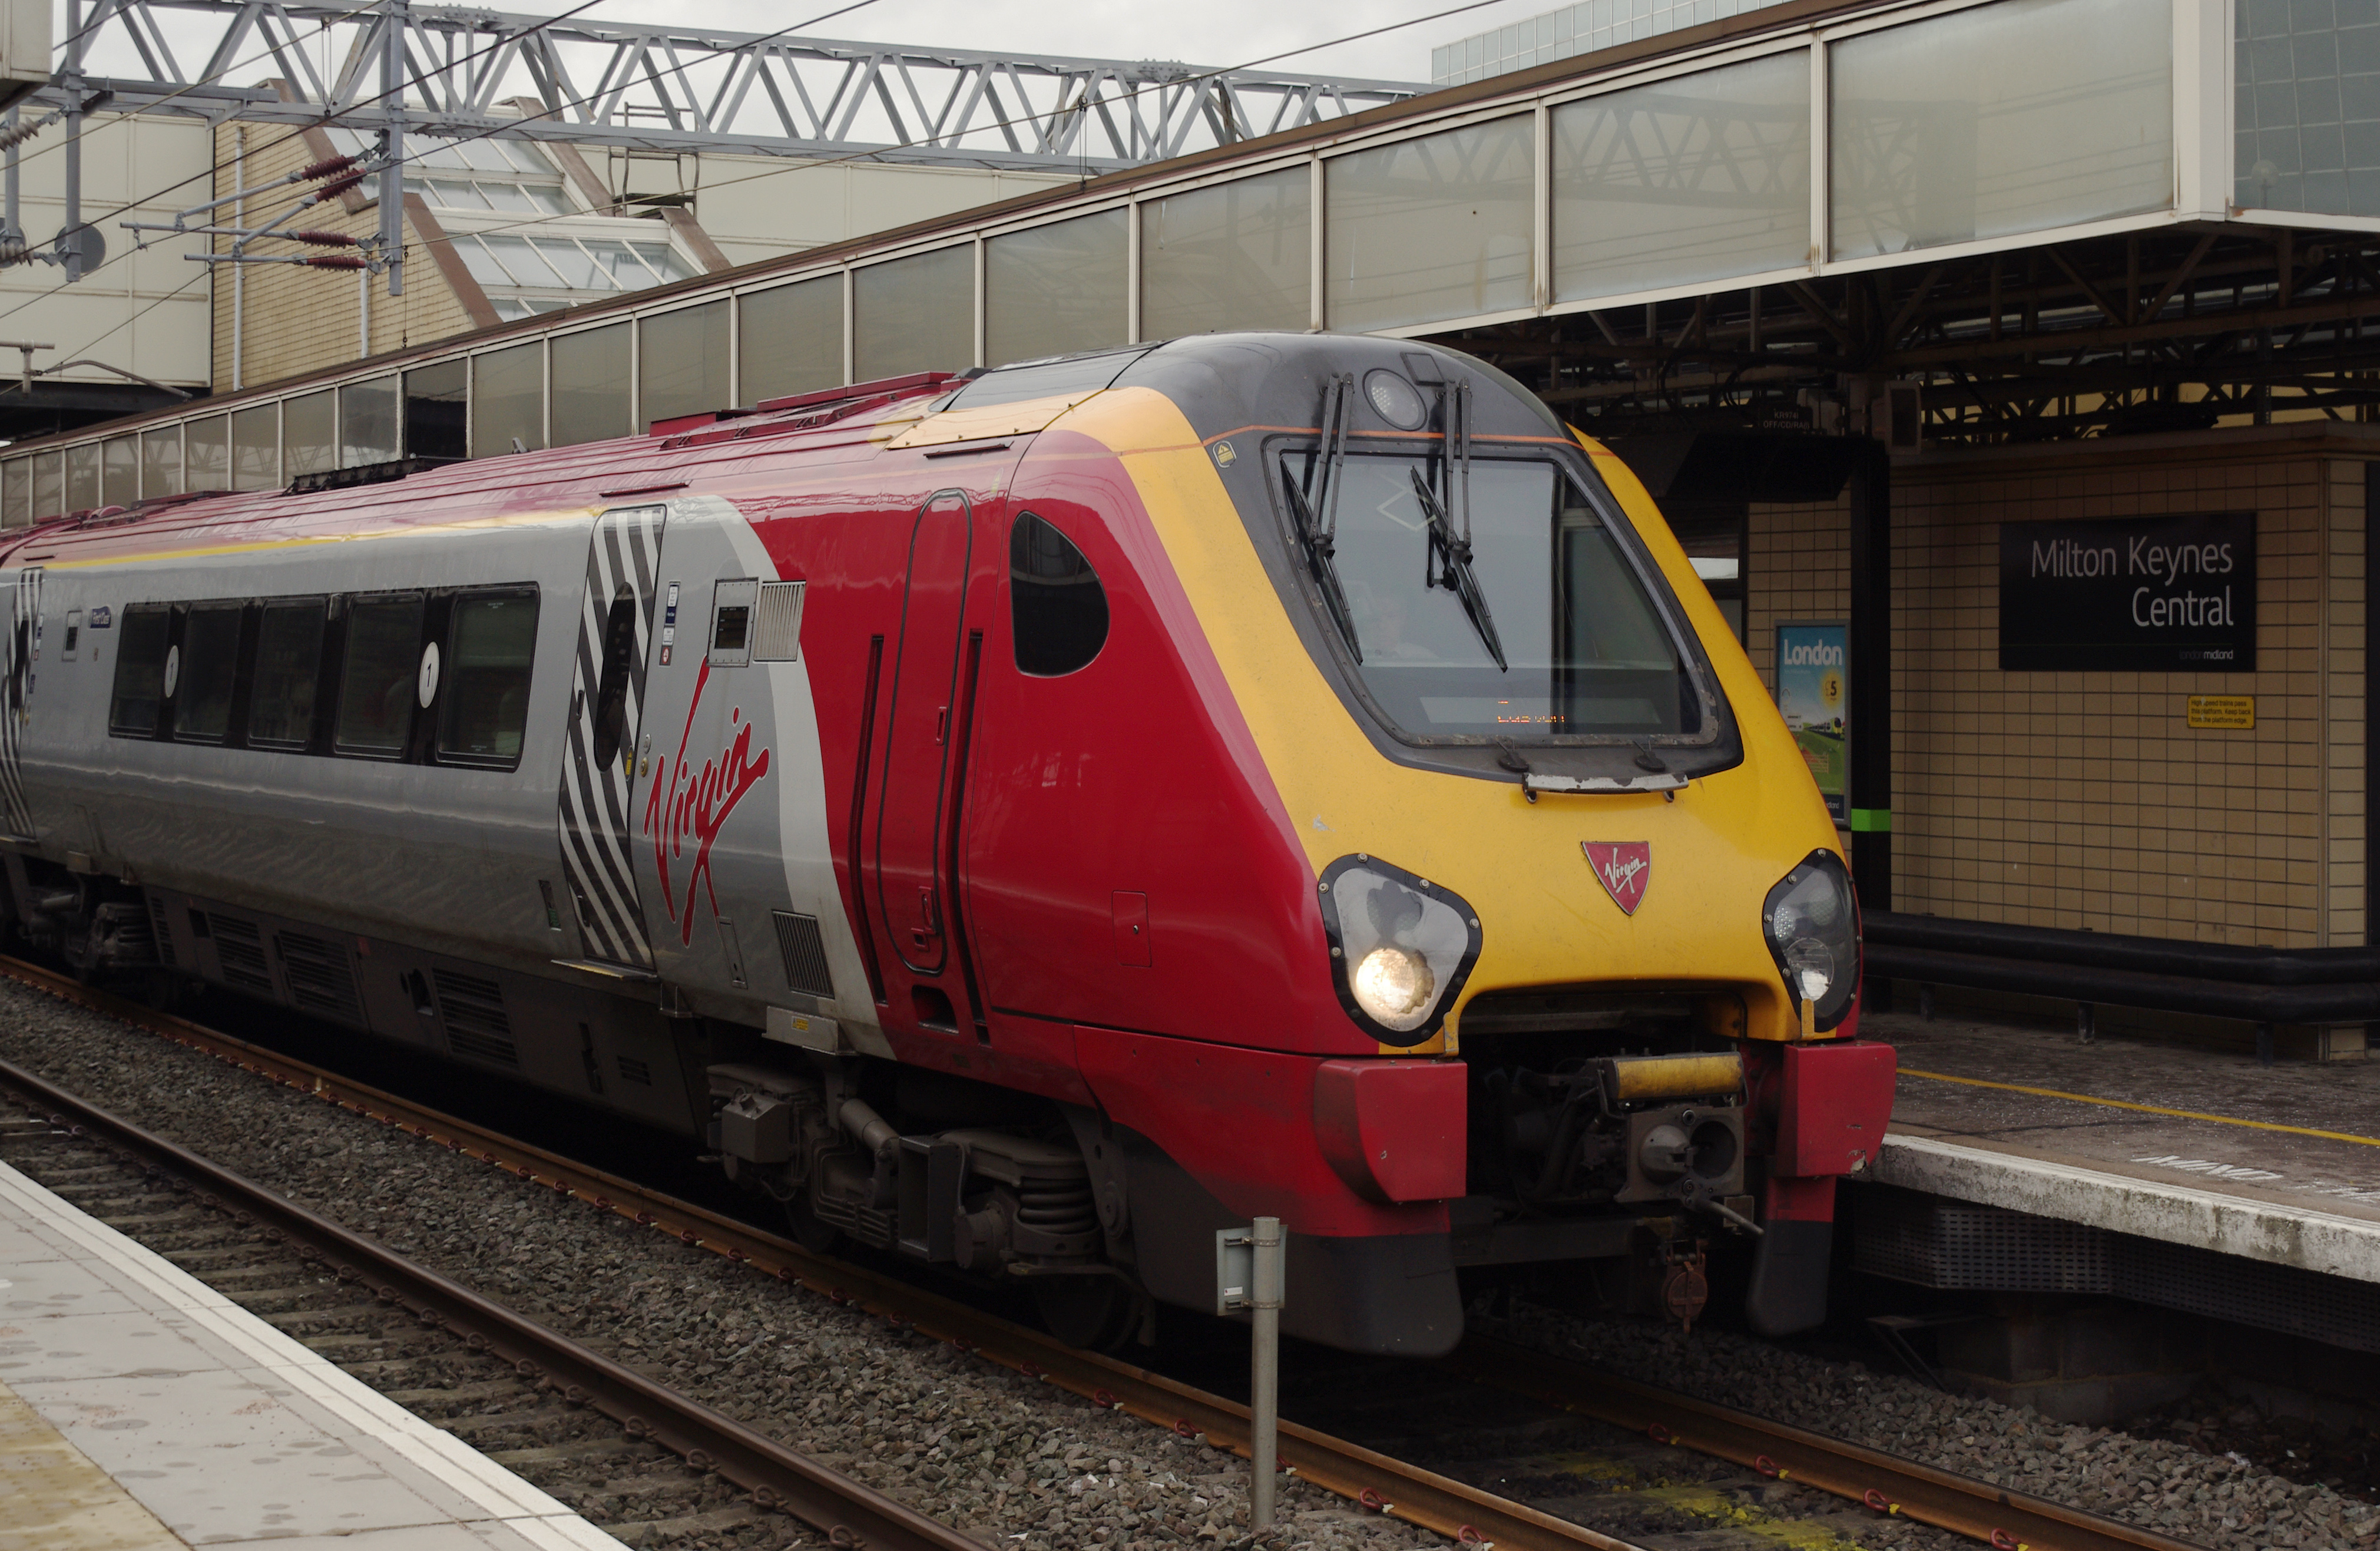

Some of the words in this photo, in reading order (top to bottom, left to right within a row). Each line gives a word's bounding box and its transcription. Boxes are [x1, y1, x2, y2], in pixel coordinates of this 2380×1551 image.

[2031, 538, 2117, 578] Milton
[2128, 535, 2233, 586] Keynes
[2132, 585, 2234, 627] Central
[1783, 638, 1843, 666] London
[427, 663, 432, 687] 1
[644, 655, 770, 947] Virgin
[1604, 846, 1647, 894] Virgin
